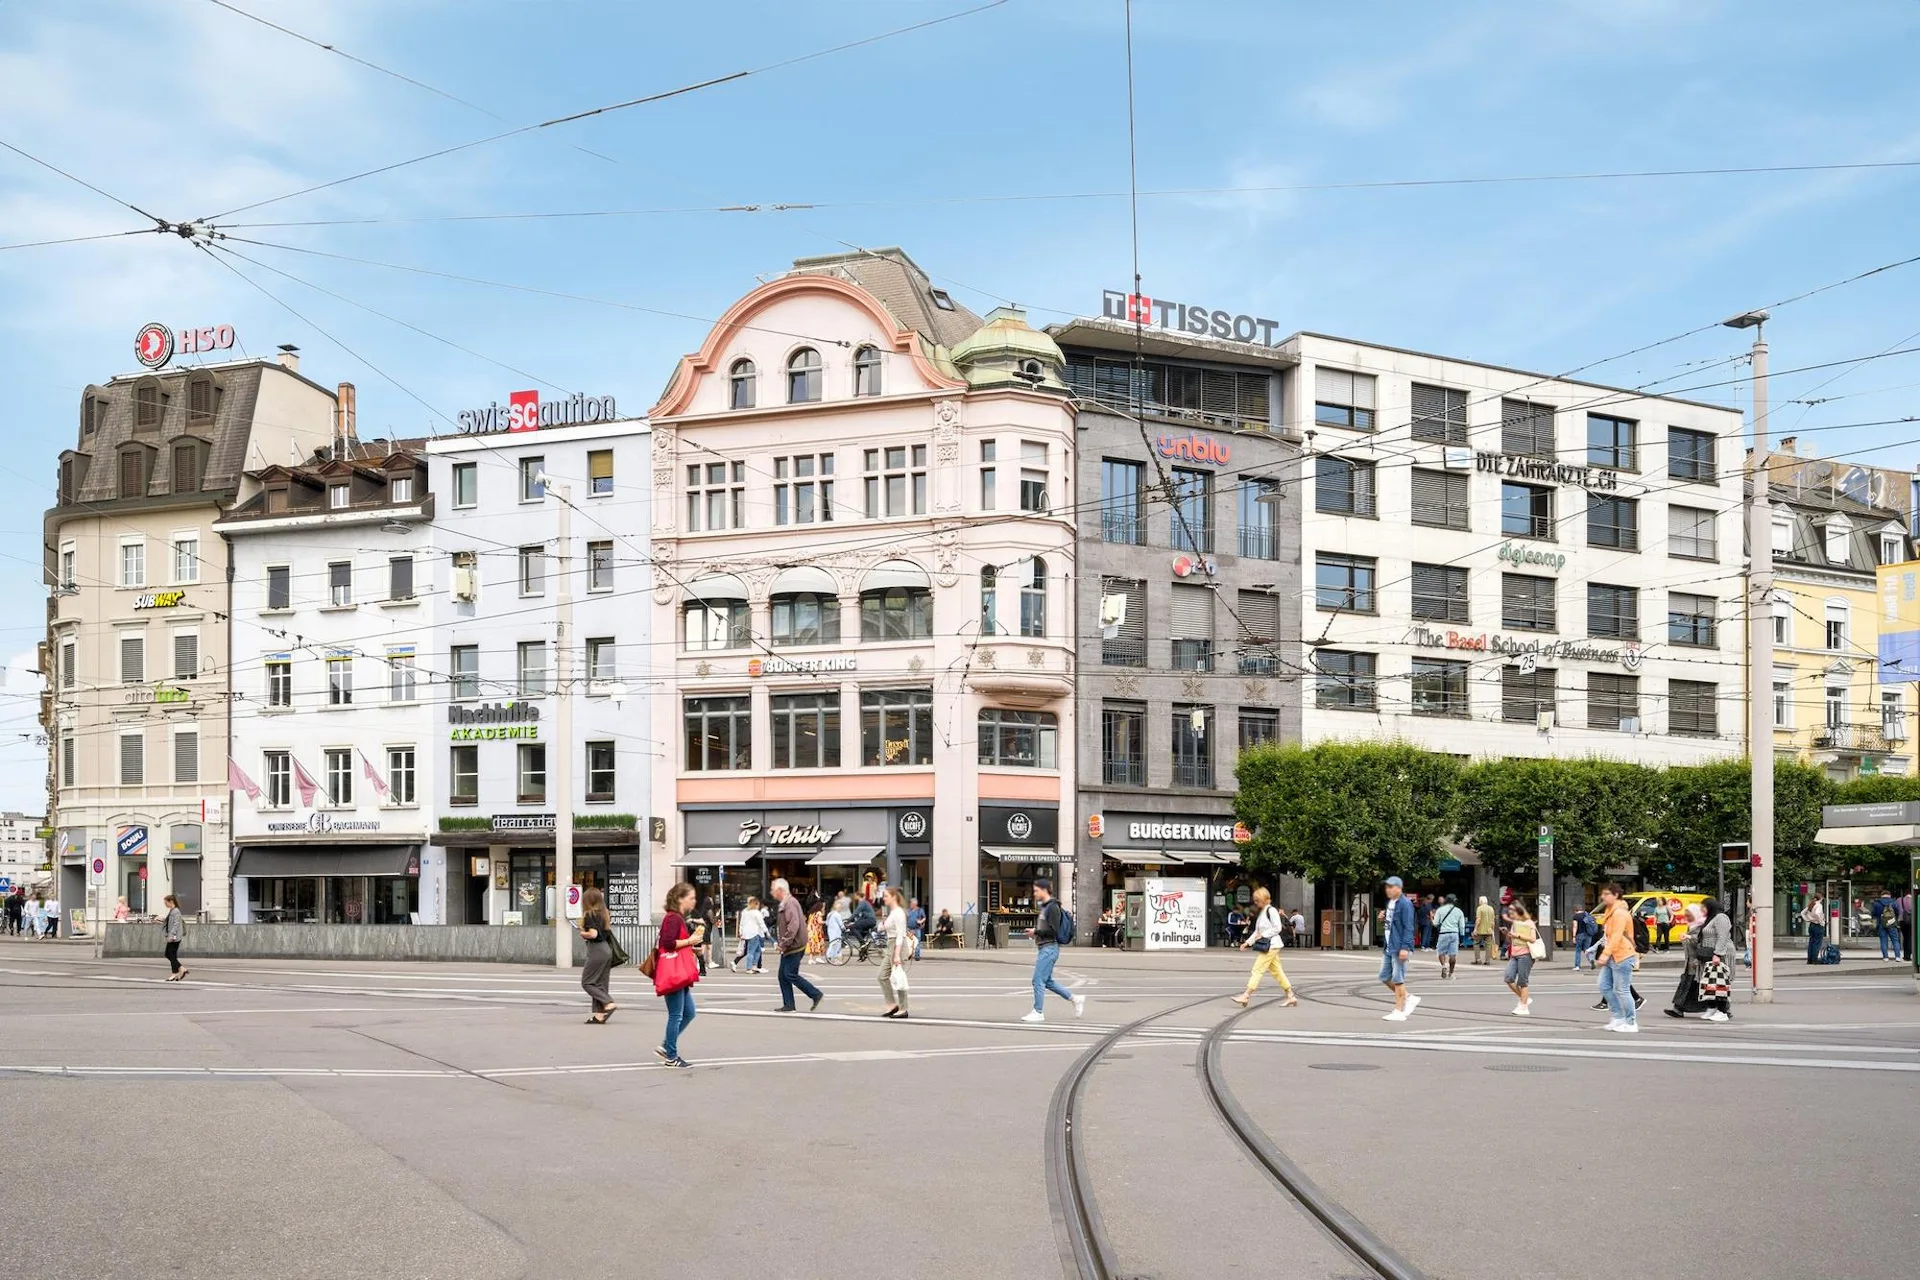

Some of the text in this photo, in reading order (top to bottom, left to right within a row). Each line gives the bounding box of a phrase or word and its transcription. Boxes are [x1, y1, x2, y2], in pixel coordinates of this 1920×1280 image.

[1152, 299, 1279, 347] TISSOT
[179, 323, 235, 353] HSO
[457, 391, 616, 433] swisscaution
[1477, 452, 1504, 475] DIE
[1498, 542, 1566, 572] digicomp
[133, 590, 186, 610] SUBWAY
[1415, 628, 1443, 647] The
[1446, 631, 1487, 651] Basel
[1491, 635, 1539, 653] School
[1543, 641, 1558, 661] of
[1561, 642, 1619, 663] Business
[821, 658, 856, 670] KING
[1521, 654, 1535, 670] 25
[448, 701, 540, 724] Nachhilfe
[36, 736, 48, 746] 25
[450, 725, 538, 740] AKADEMIE
[333, 821, 380, 830] BACHMANN
[492, 815, 556, 829] dean&da
[1541, 826, 1548, 835] D
[121, 829, 144, 850] BOWLS
[767, 825, 842, 844] Tchibo
[1130, 823, 1232, 841] BURGER KING
[609, 885, 638, 893] SALADS
[1162, 932, 1201, 944] inlingua
